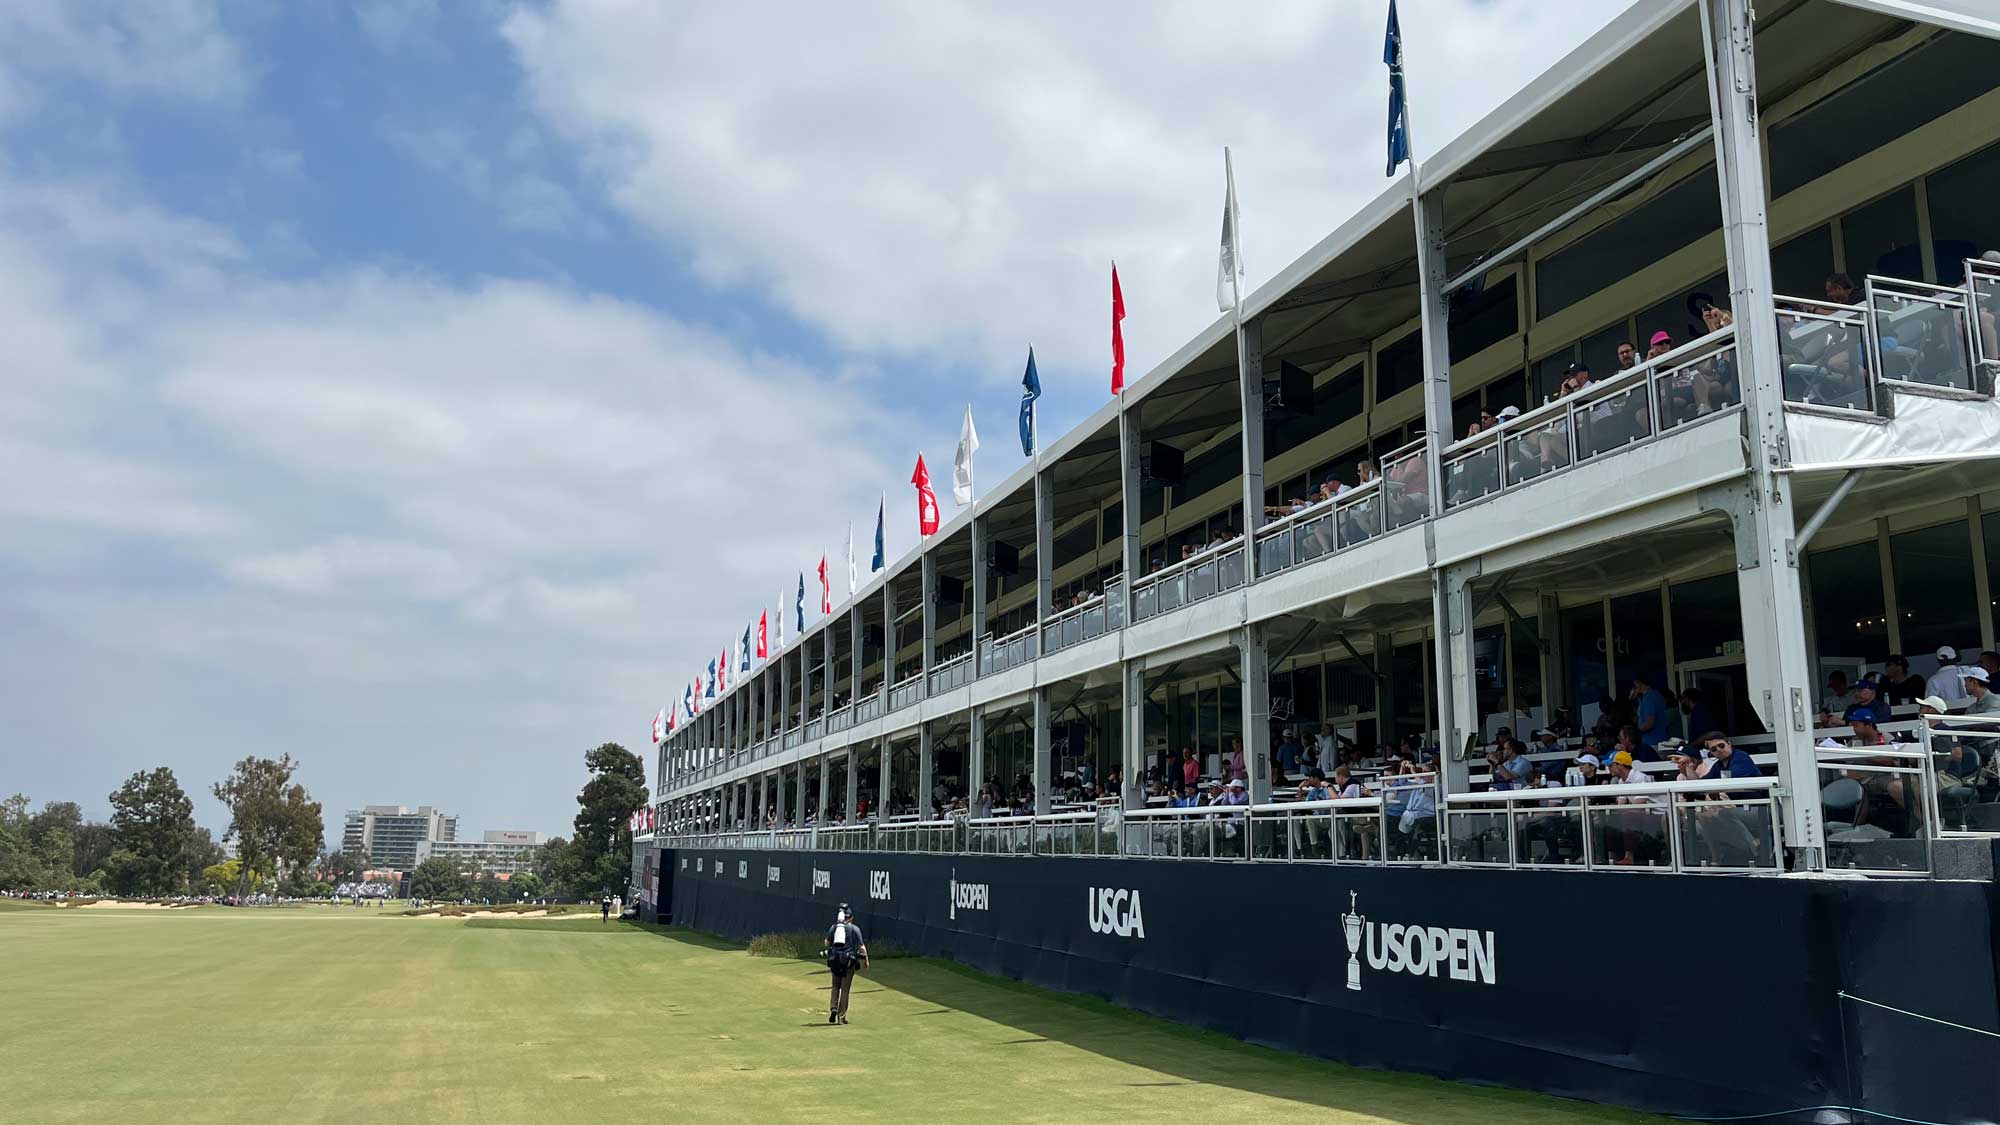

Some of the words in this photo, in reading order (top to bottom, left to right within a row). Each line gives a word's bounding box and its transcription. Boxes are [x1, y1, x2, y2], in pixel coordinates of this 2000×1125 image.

[1596, 633, 1630, 654] cti
[869, 870, 891, 900] USGA
[956, 883, 989, 911] USOPEN
[1088, 886, 1145, 939] USGA
[1366, 921, 1496, 985] USOPEN
